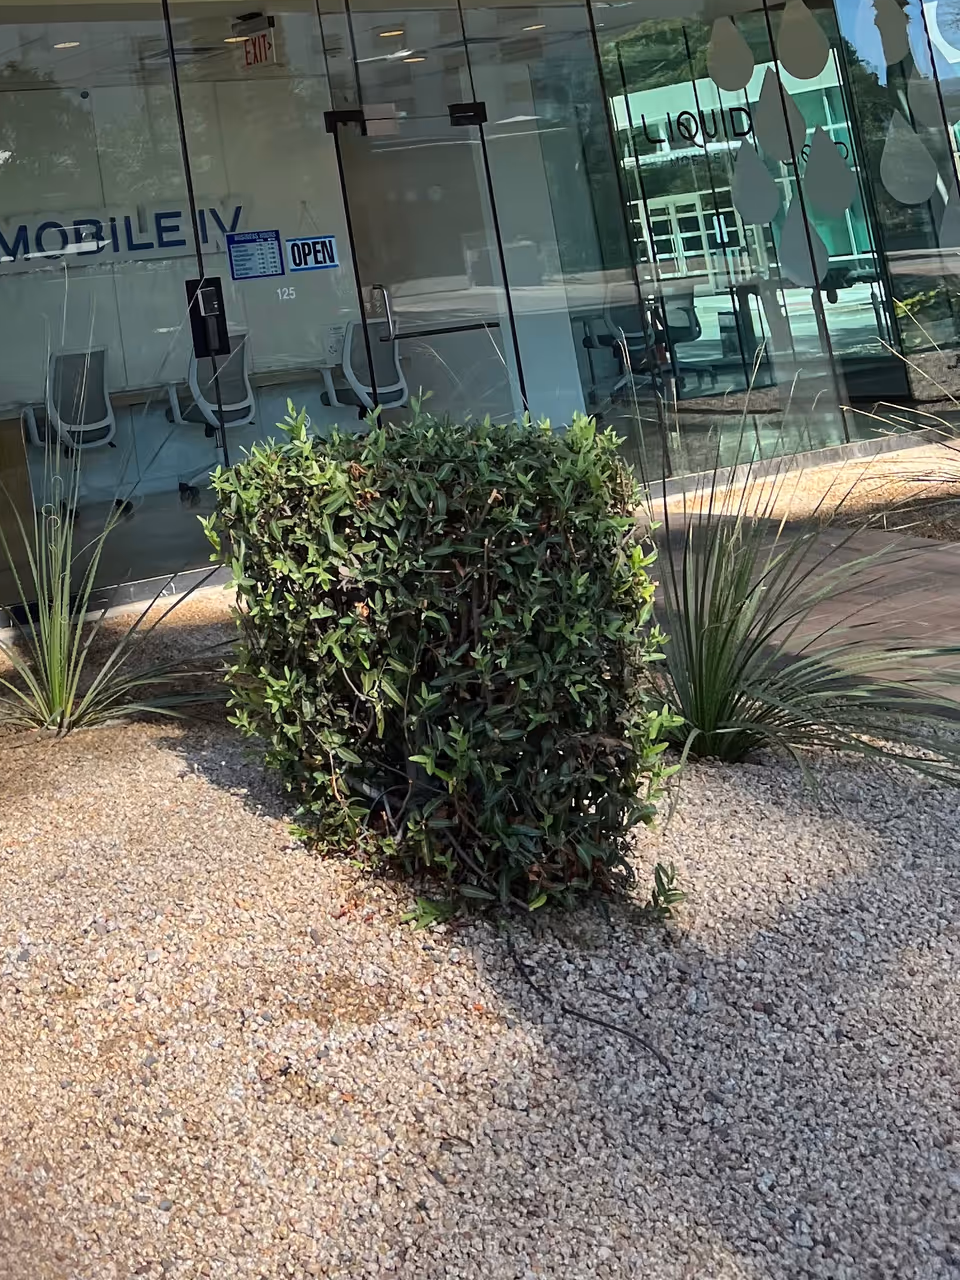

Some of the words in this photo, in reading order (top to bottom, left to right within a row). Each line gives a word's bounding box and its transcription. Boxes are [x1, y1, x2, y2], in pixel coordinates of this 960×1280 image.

[243, 34, 268, 65] EXIT
[641, 107, 753, 148] LIQUID
[198, 206, 242, 244] IV
[290, 239, 335, 267] OPEN
[276, 287, 296, 300] 125
